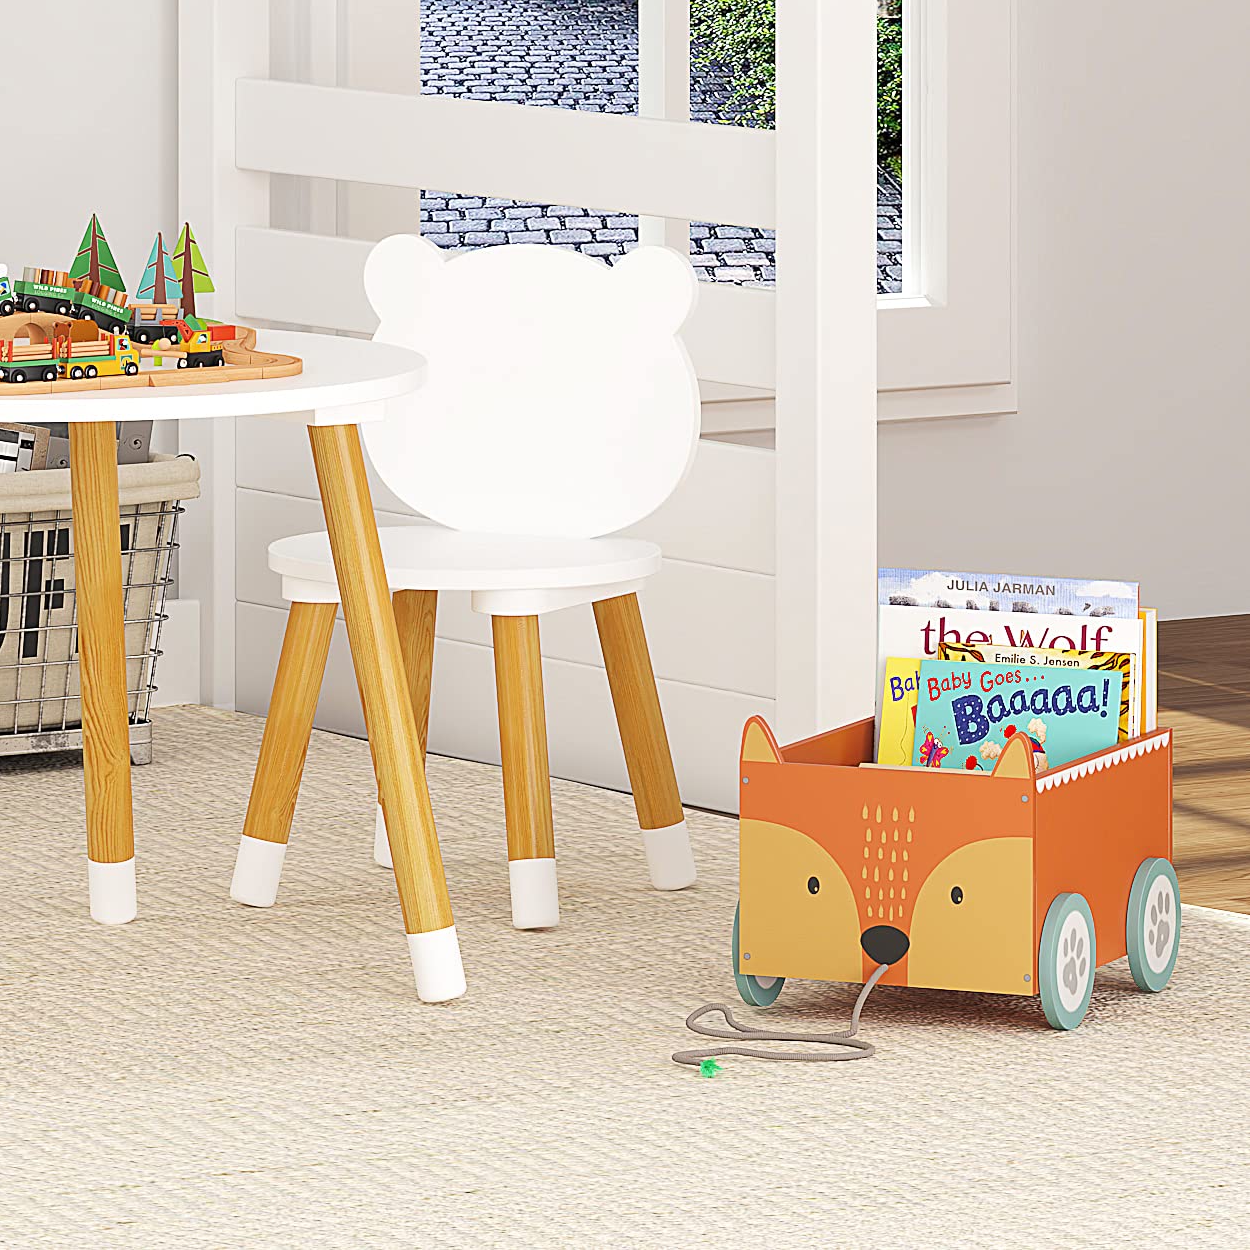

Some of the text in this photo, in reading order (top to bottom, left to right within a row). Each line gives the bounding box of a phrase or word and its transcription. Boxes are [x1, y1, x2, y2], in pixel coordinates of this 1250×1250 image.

[946, 579, 1056, 596] JULIA JARMAN
[994, 653, 1026, 665] Emilie
[1029, 654, 1040, 665] S.
[927, 670, 1045, 701] Baby Goes...
[951, 678, 1110, 745] Baaaaa!
